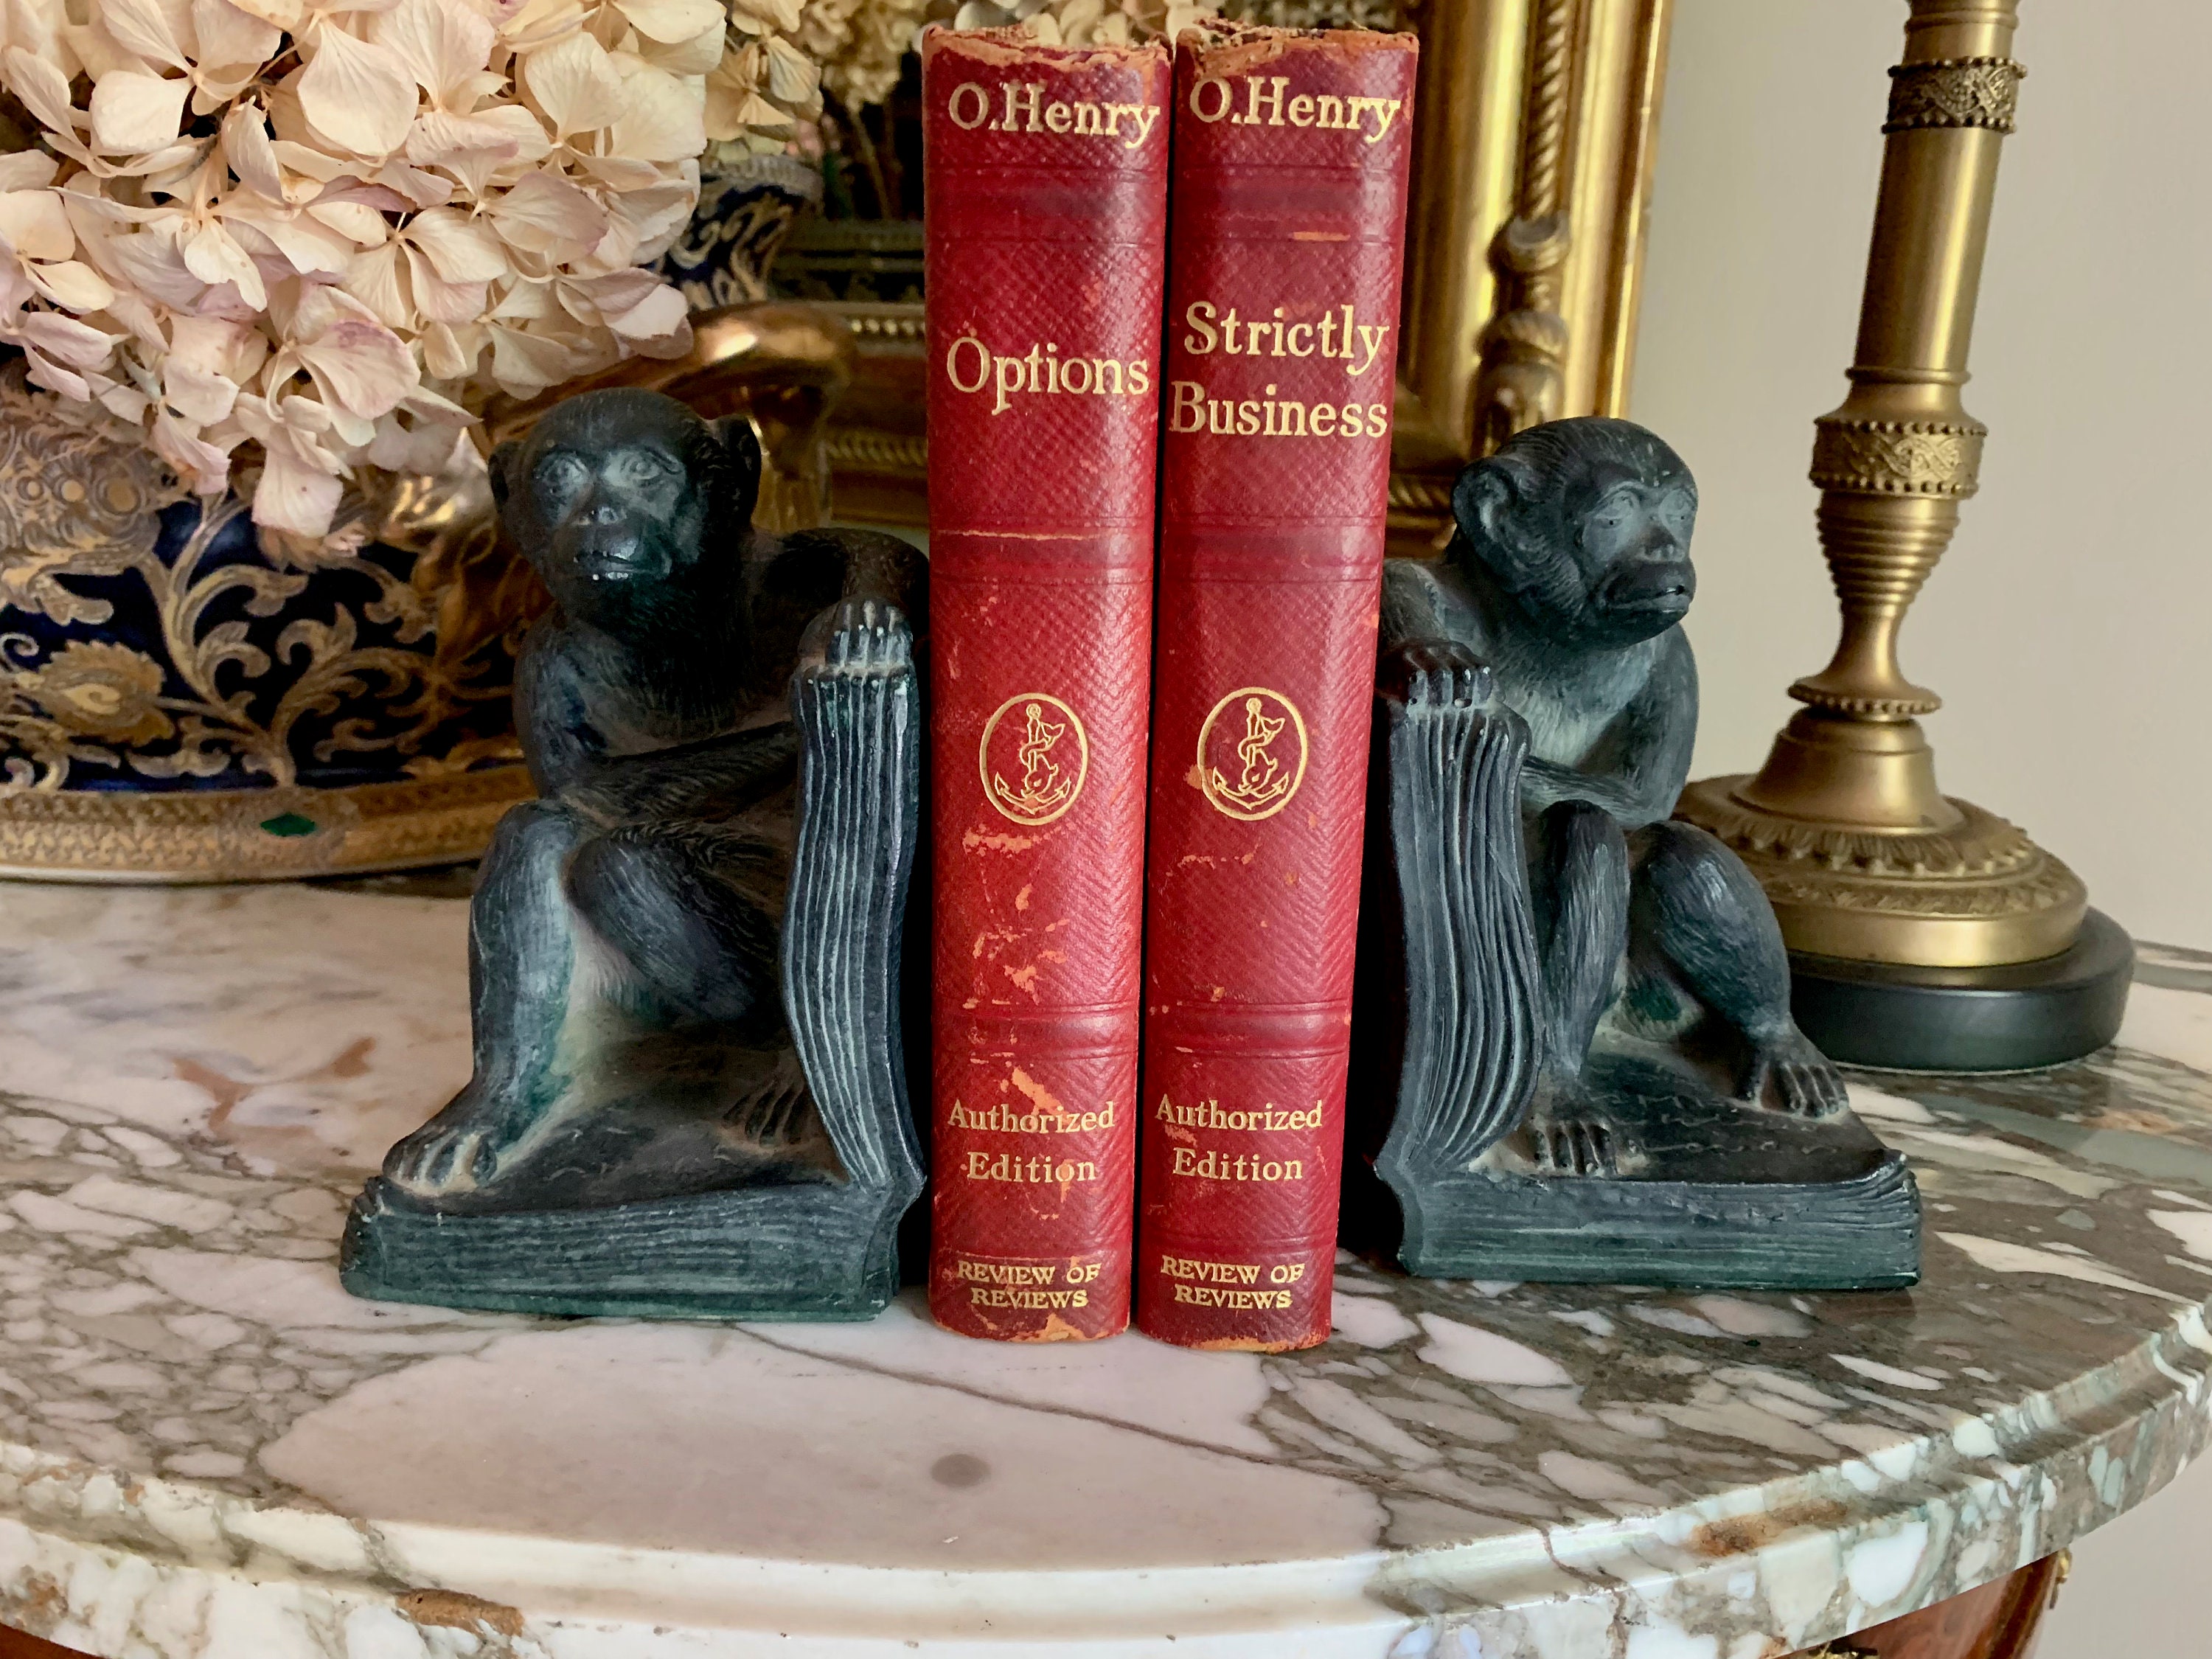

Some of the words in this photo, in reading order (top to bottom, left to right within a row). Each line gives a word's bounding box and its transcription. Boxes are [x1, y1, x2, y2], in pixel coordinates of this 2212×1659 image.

[1183, 301, 1390, 375] Strictly
[947, 335, 1150, 415] Options
[1170, 380, 1388, 438] Business
[947, 1099, 1116, 1134] Authorized
[1155, 1093, 1323, 1131] Authorized
[966, 1151, 1096, 1183] Edition
[1172, 1147, 1303, 1181] Edition
[957, 1260, 1055, 1284] REVIEW
[1066, 1262, 1102, 1283] OF
[1160, 1254, 1262, 1284] REVIEW
[1270, 1262, 1306, 1283] OF
[970, 1287, 1089, 1309] REVIEWS
[1174, 1284, 1293, 1310] REVIEWS
